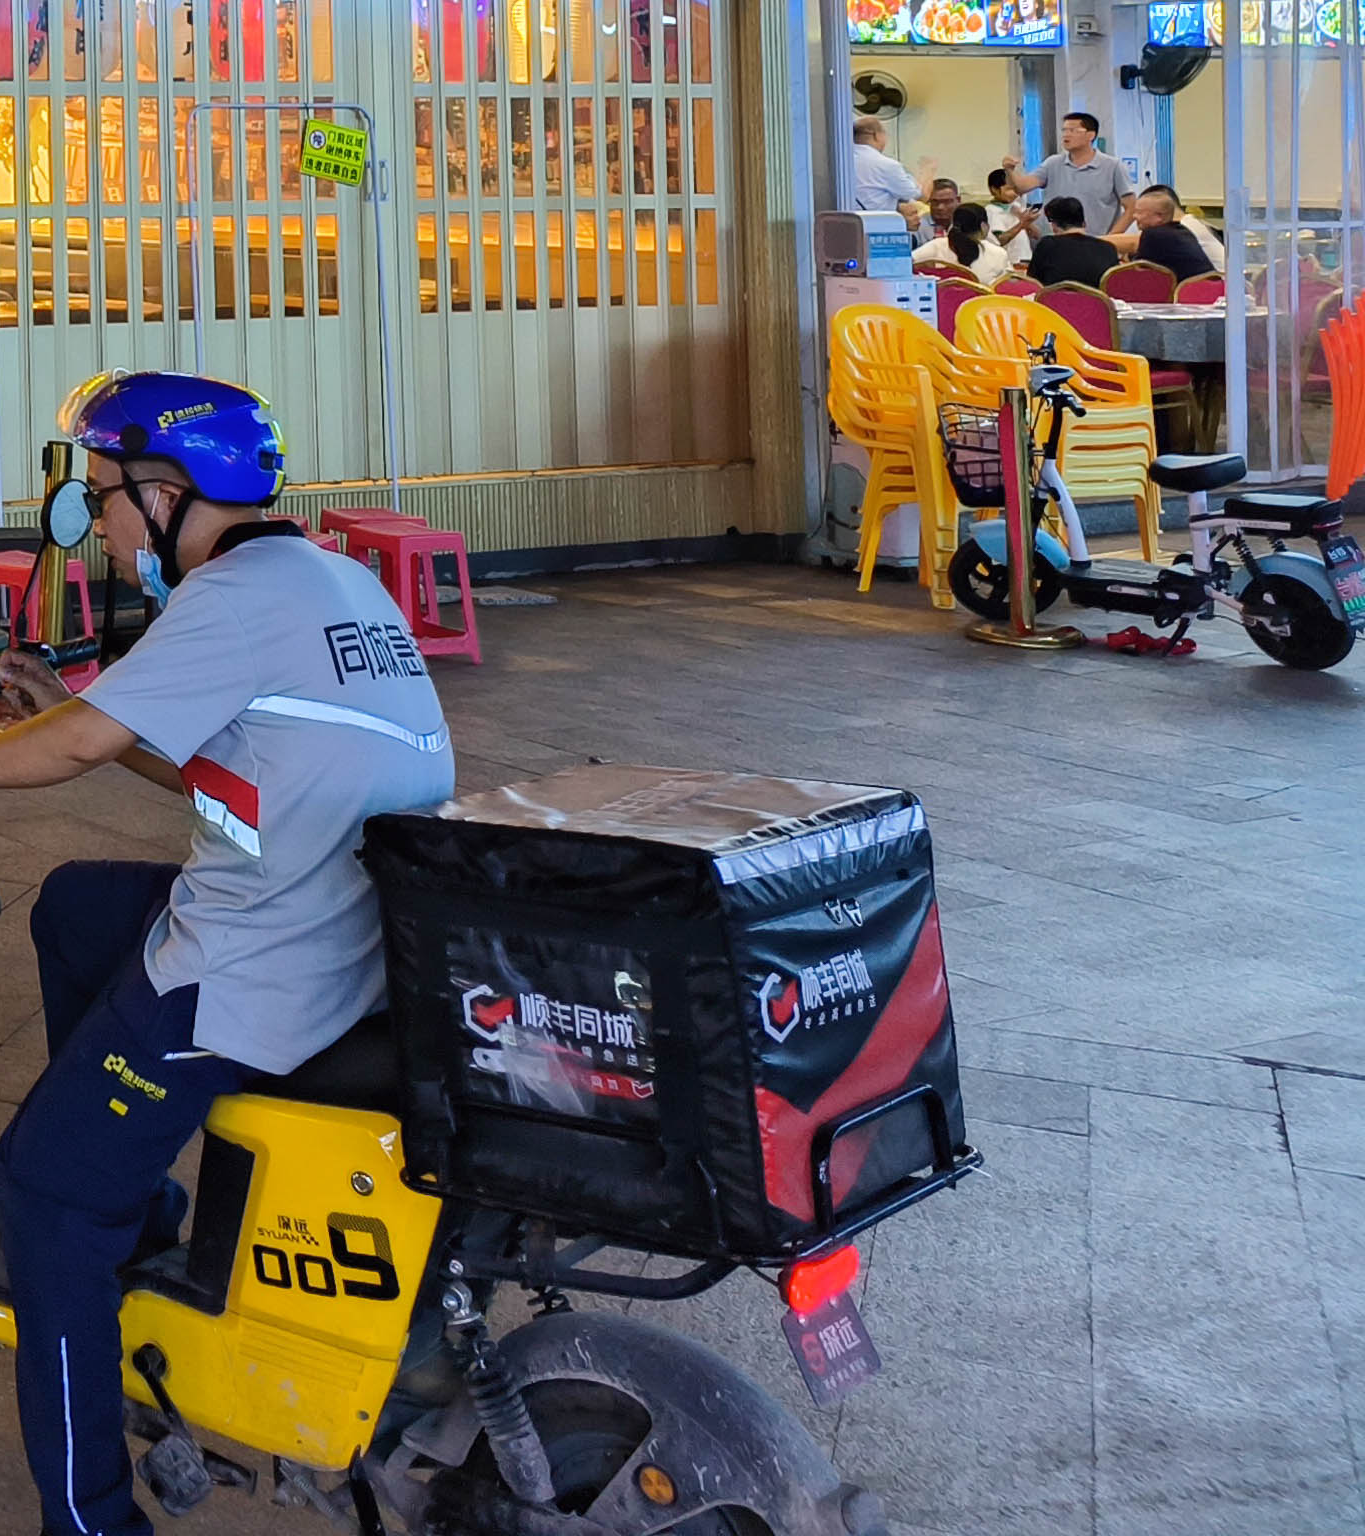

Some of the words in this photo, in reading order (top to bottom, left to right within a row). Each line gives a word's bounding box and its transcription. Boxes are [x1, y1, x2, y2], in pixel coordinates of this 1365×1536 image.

[324, 620, 427, 686] 同城急
[797, 948, 873, 1012] 顺丰同城
[519, 992, 637, 1049] 顺丰同城
[252, 1211, 401, 1302] 009
[256, 1226, 301, 1244] SYUAN
